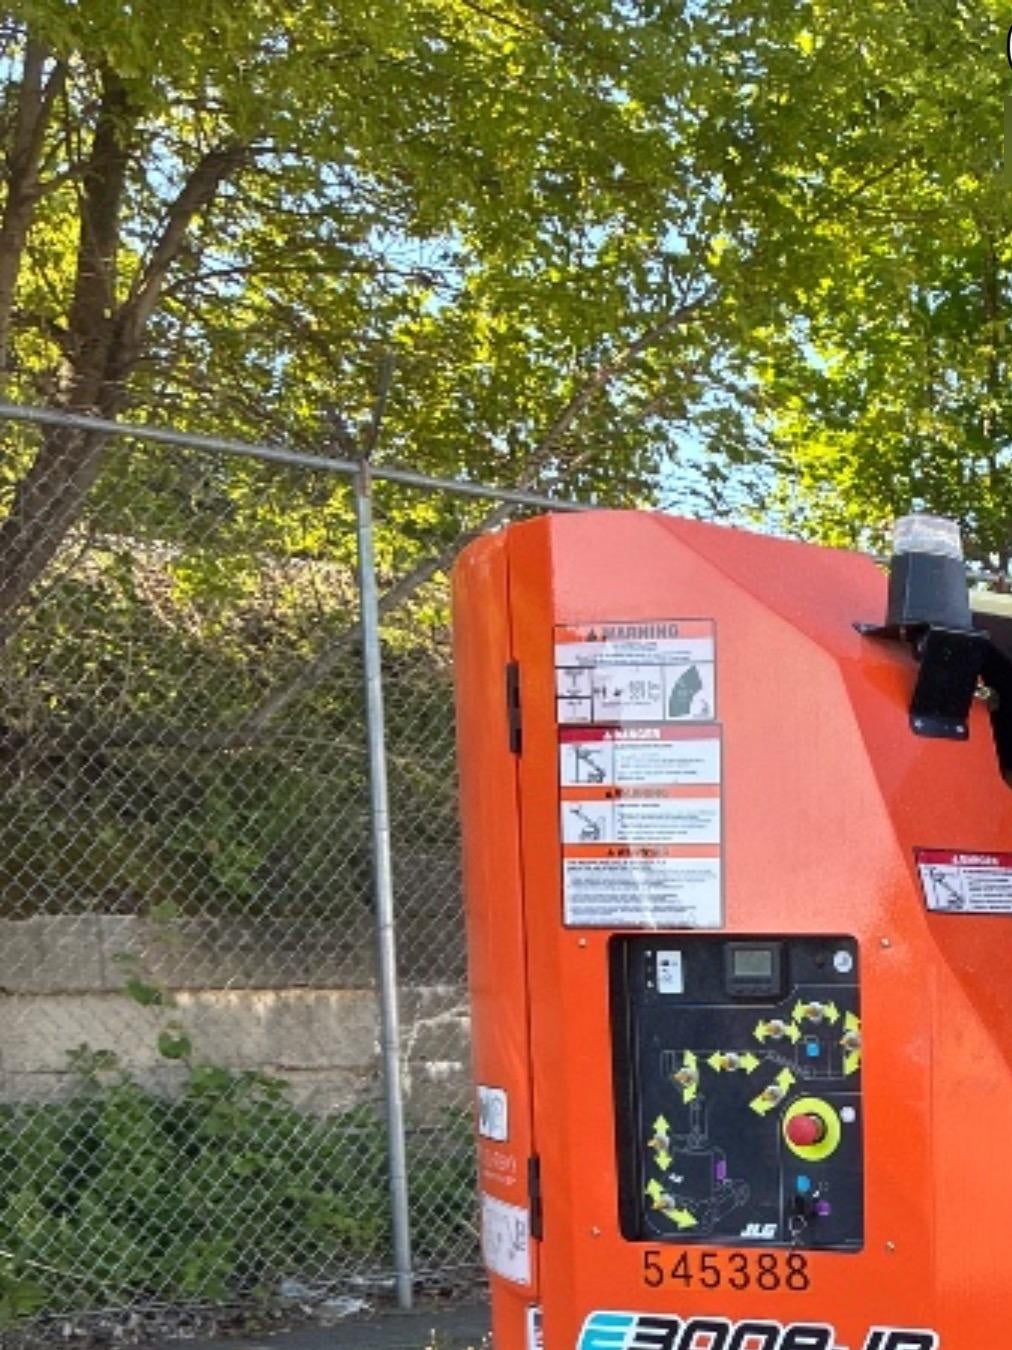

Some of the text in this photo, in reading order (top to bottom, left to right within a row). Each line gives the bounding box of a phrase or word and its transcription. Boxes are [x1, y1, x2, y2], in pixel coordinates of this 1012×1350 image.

[602, 624, 679, 641] WARNING
[740, 1222, 778, 1239] JLG
[643, 1250, 811, 1291] 545388
